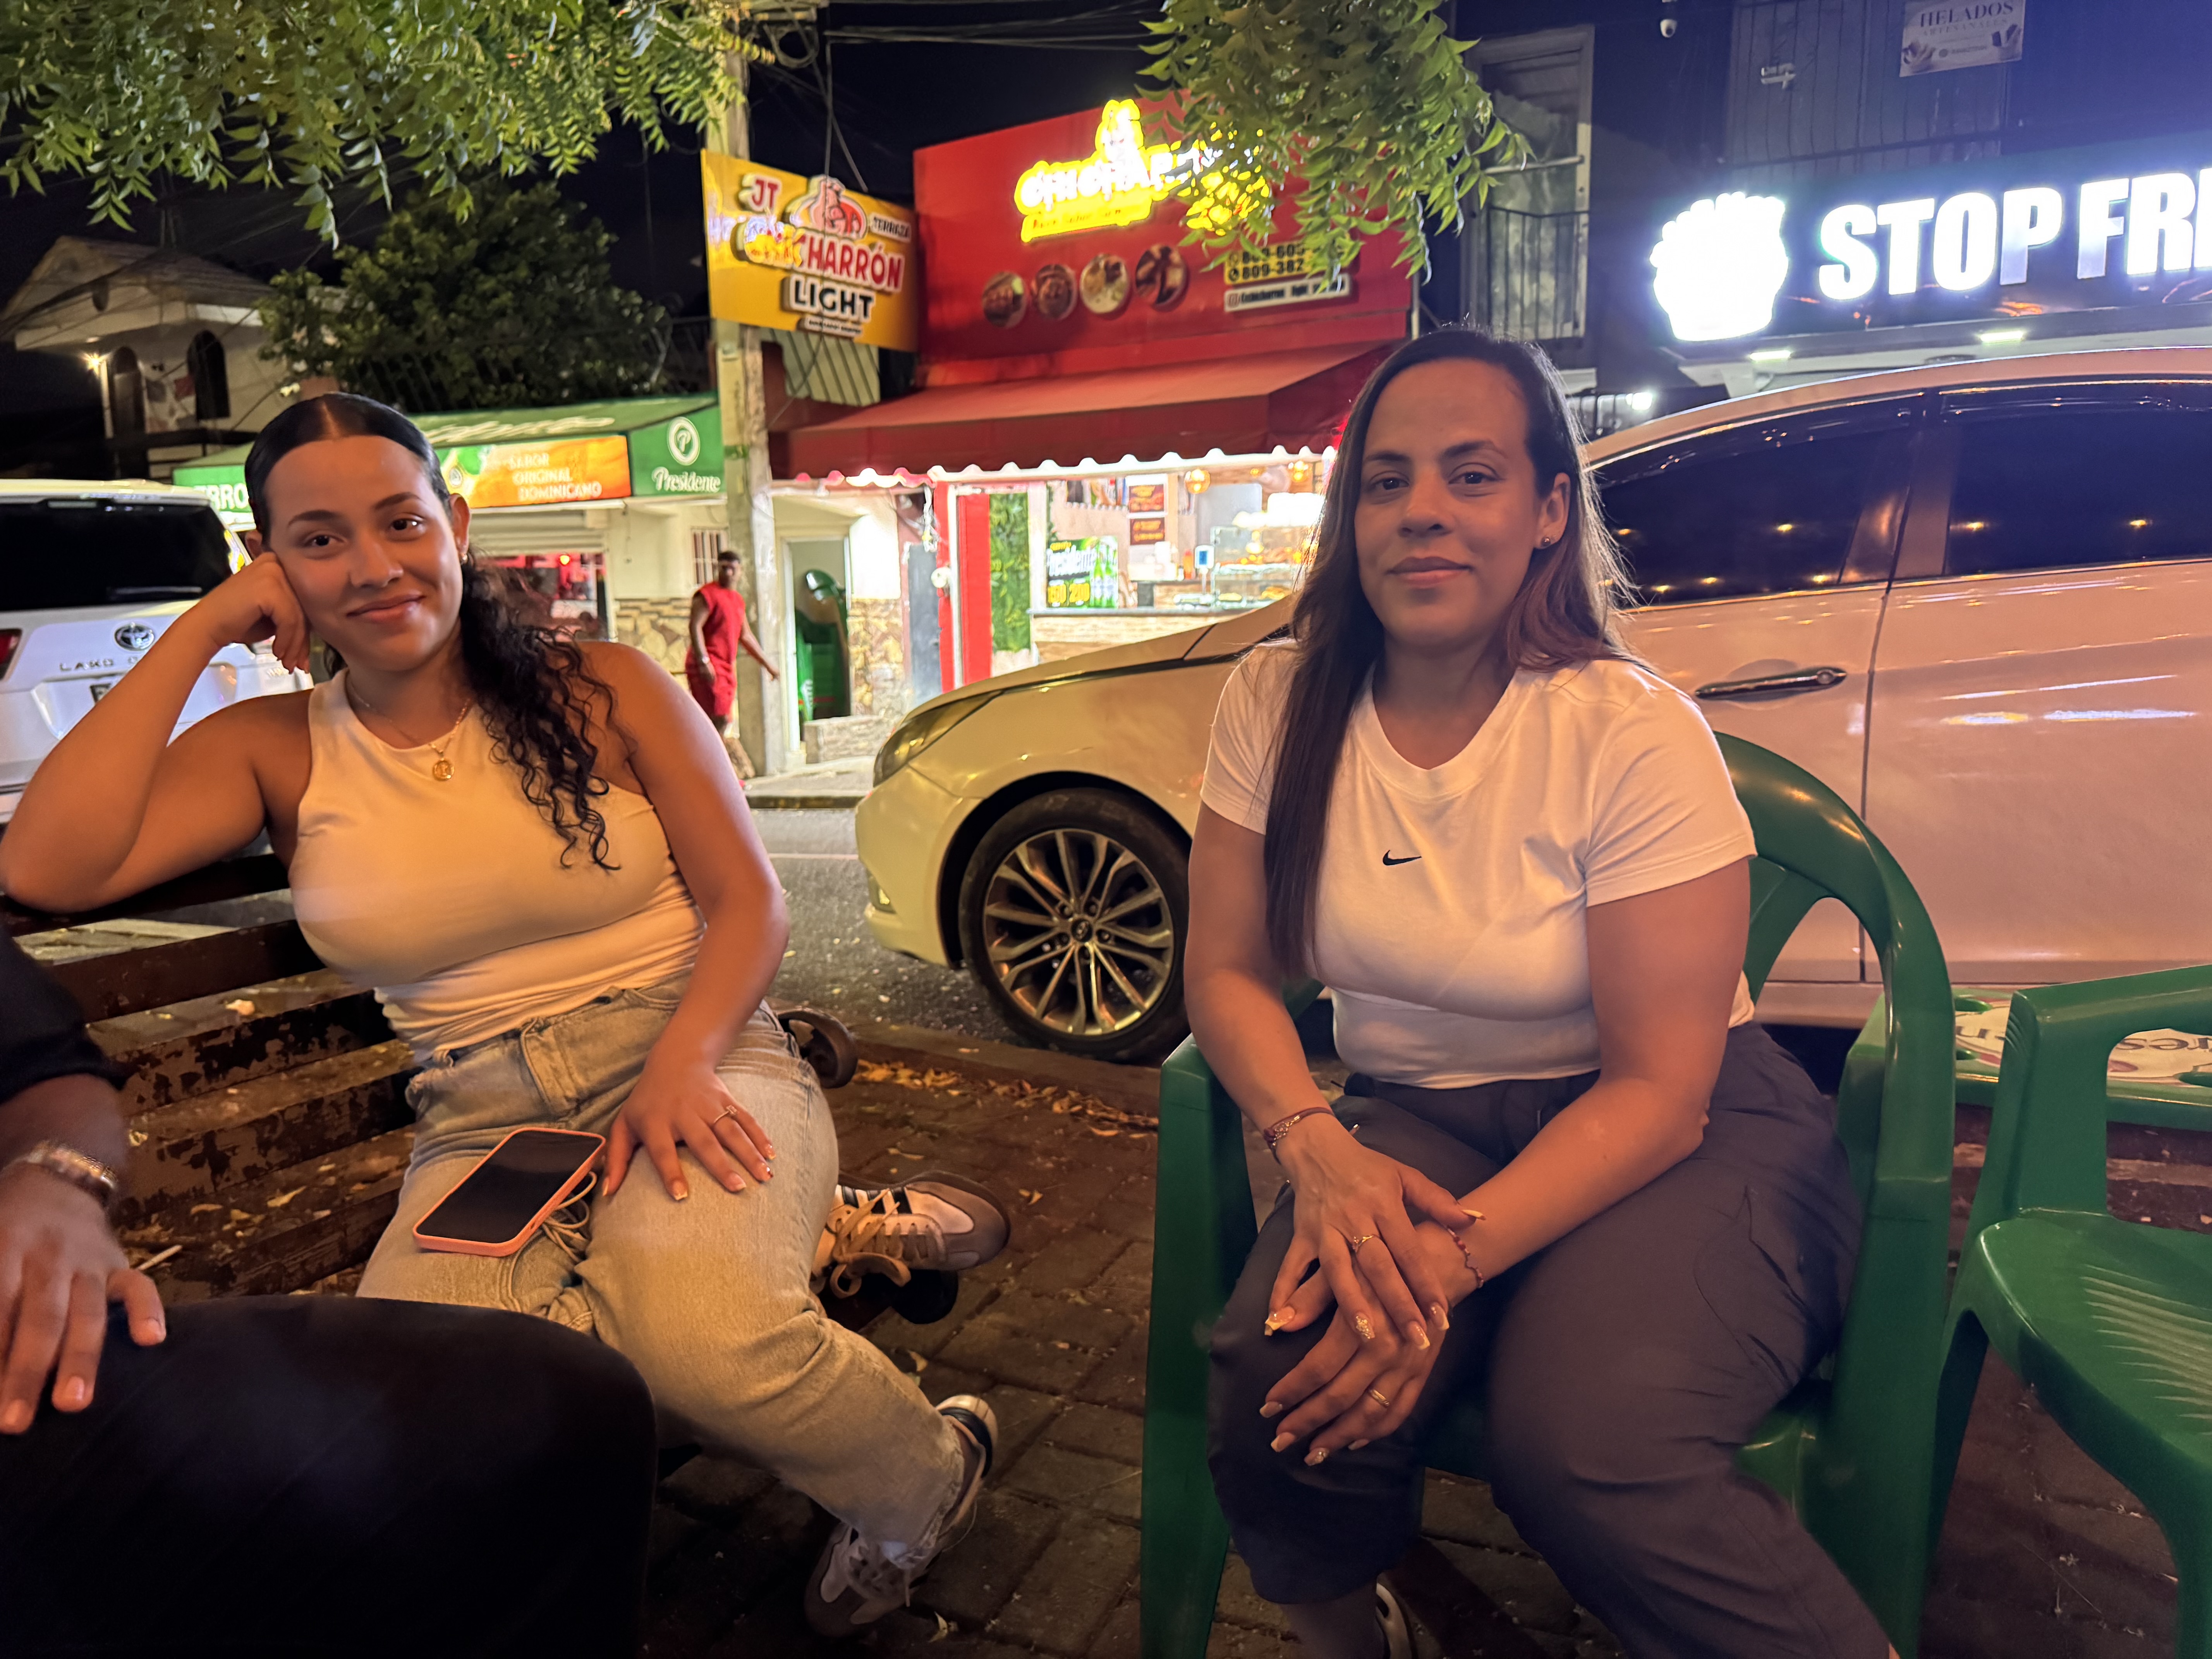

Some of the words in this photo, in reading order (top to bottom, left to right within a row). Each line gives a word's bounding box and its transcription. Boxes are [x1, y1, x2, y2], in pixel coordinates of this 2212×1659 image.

[1920, 2, 2013, 27] HELADOS
[752, 179, 779, 210] JT
[1819, 186, 2063, 301] STOP
[794, 280, 874, 319] LIGHT
[508, 452, 550, 471] SABOR
[512, 467, 573, 486] ORIGINAL
[651, 466, 721, 493] Presidente
[194, 483, 249, 510] RRO
[519, 481, 603, 502] DOMINICANO
